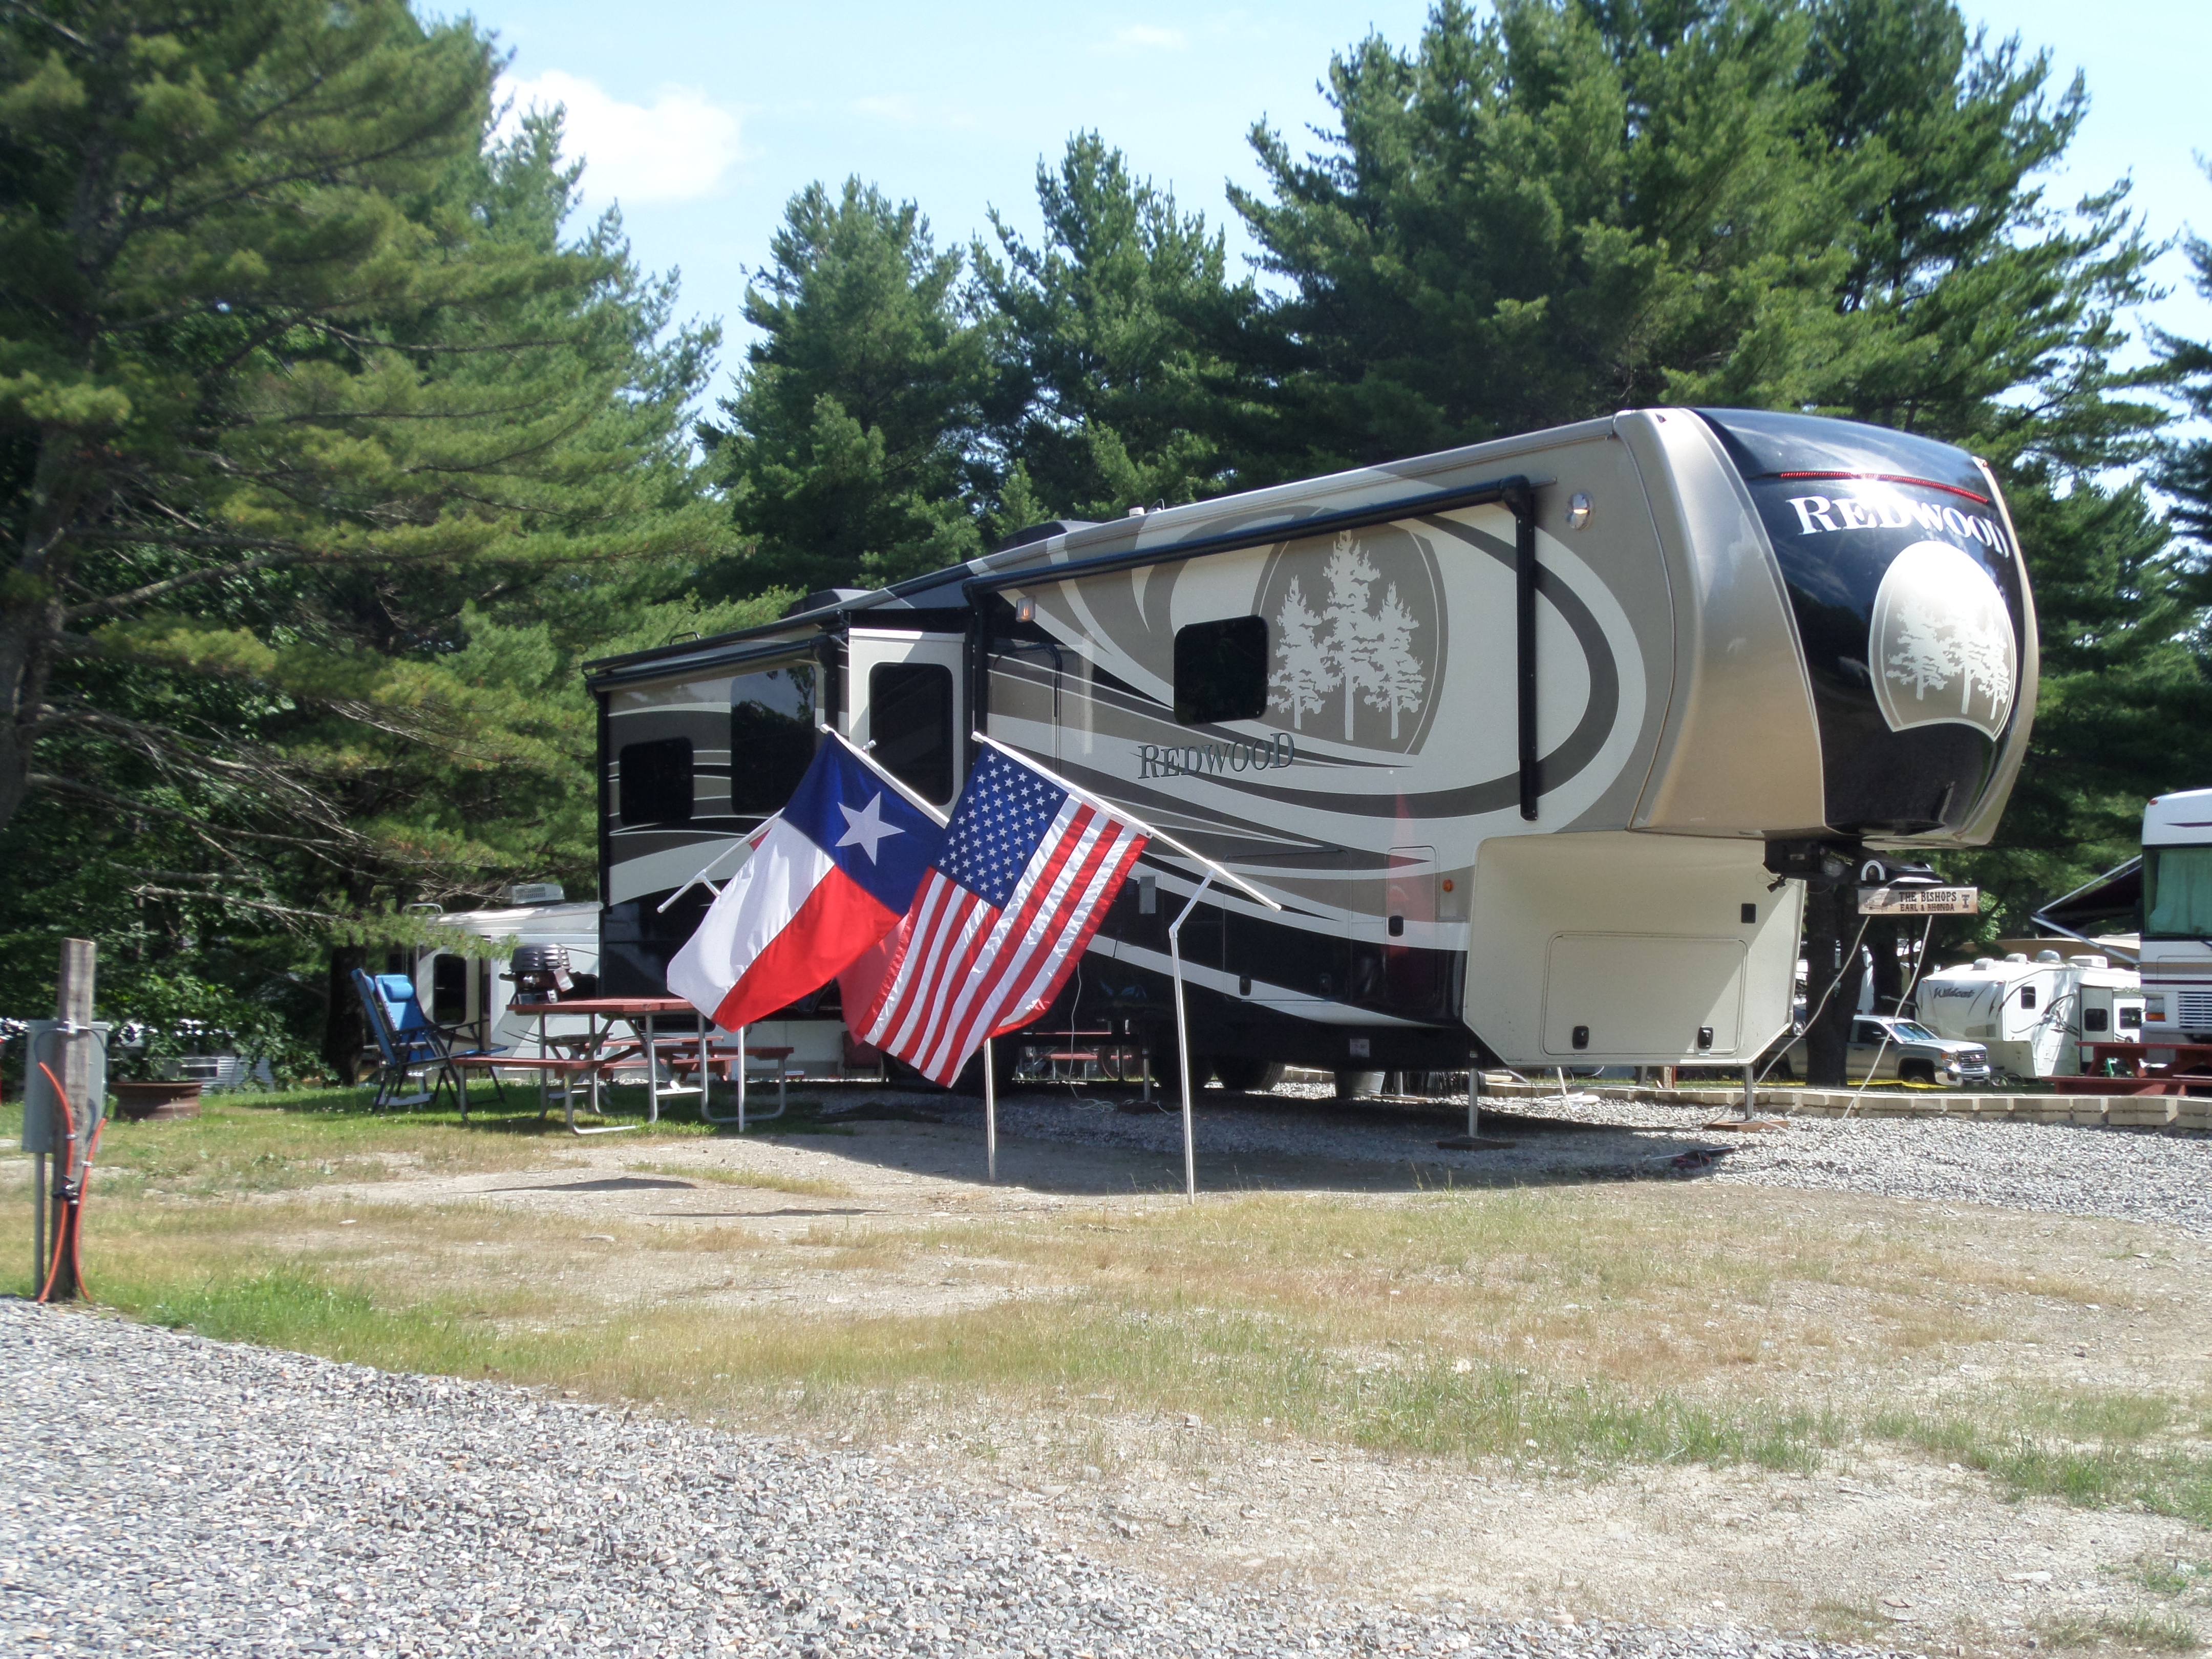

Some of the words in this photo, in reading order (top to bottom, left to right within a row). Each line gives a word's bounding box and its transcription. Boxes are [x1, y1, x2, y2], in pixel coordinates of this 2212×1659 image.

[1785, 496, 2010, 558] REDWOOD
[1138, 732, 1295, 779] REDWOOD
[1899, 891, 1917, 902] THE
[1921, 891, 1957, 902] BISHOPS
